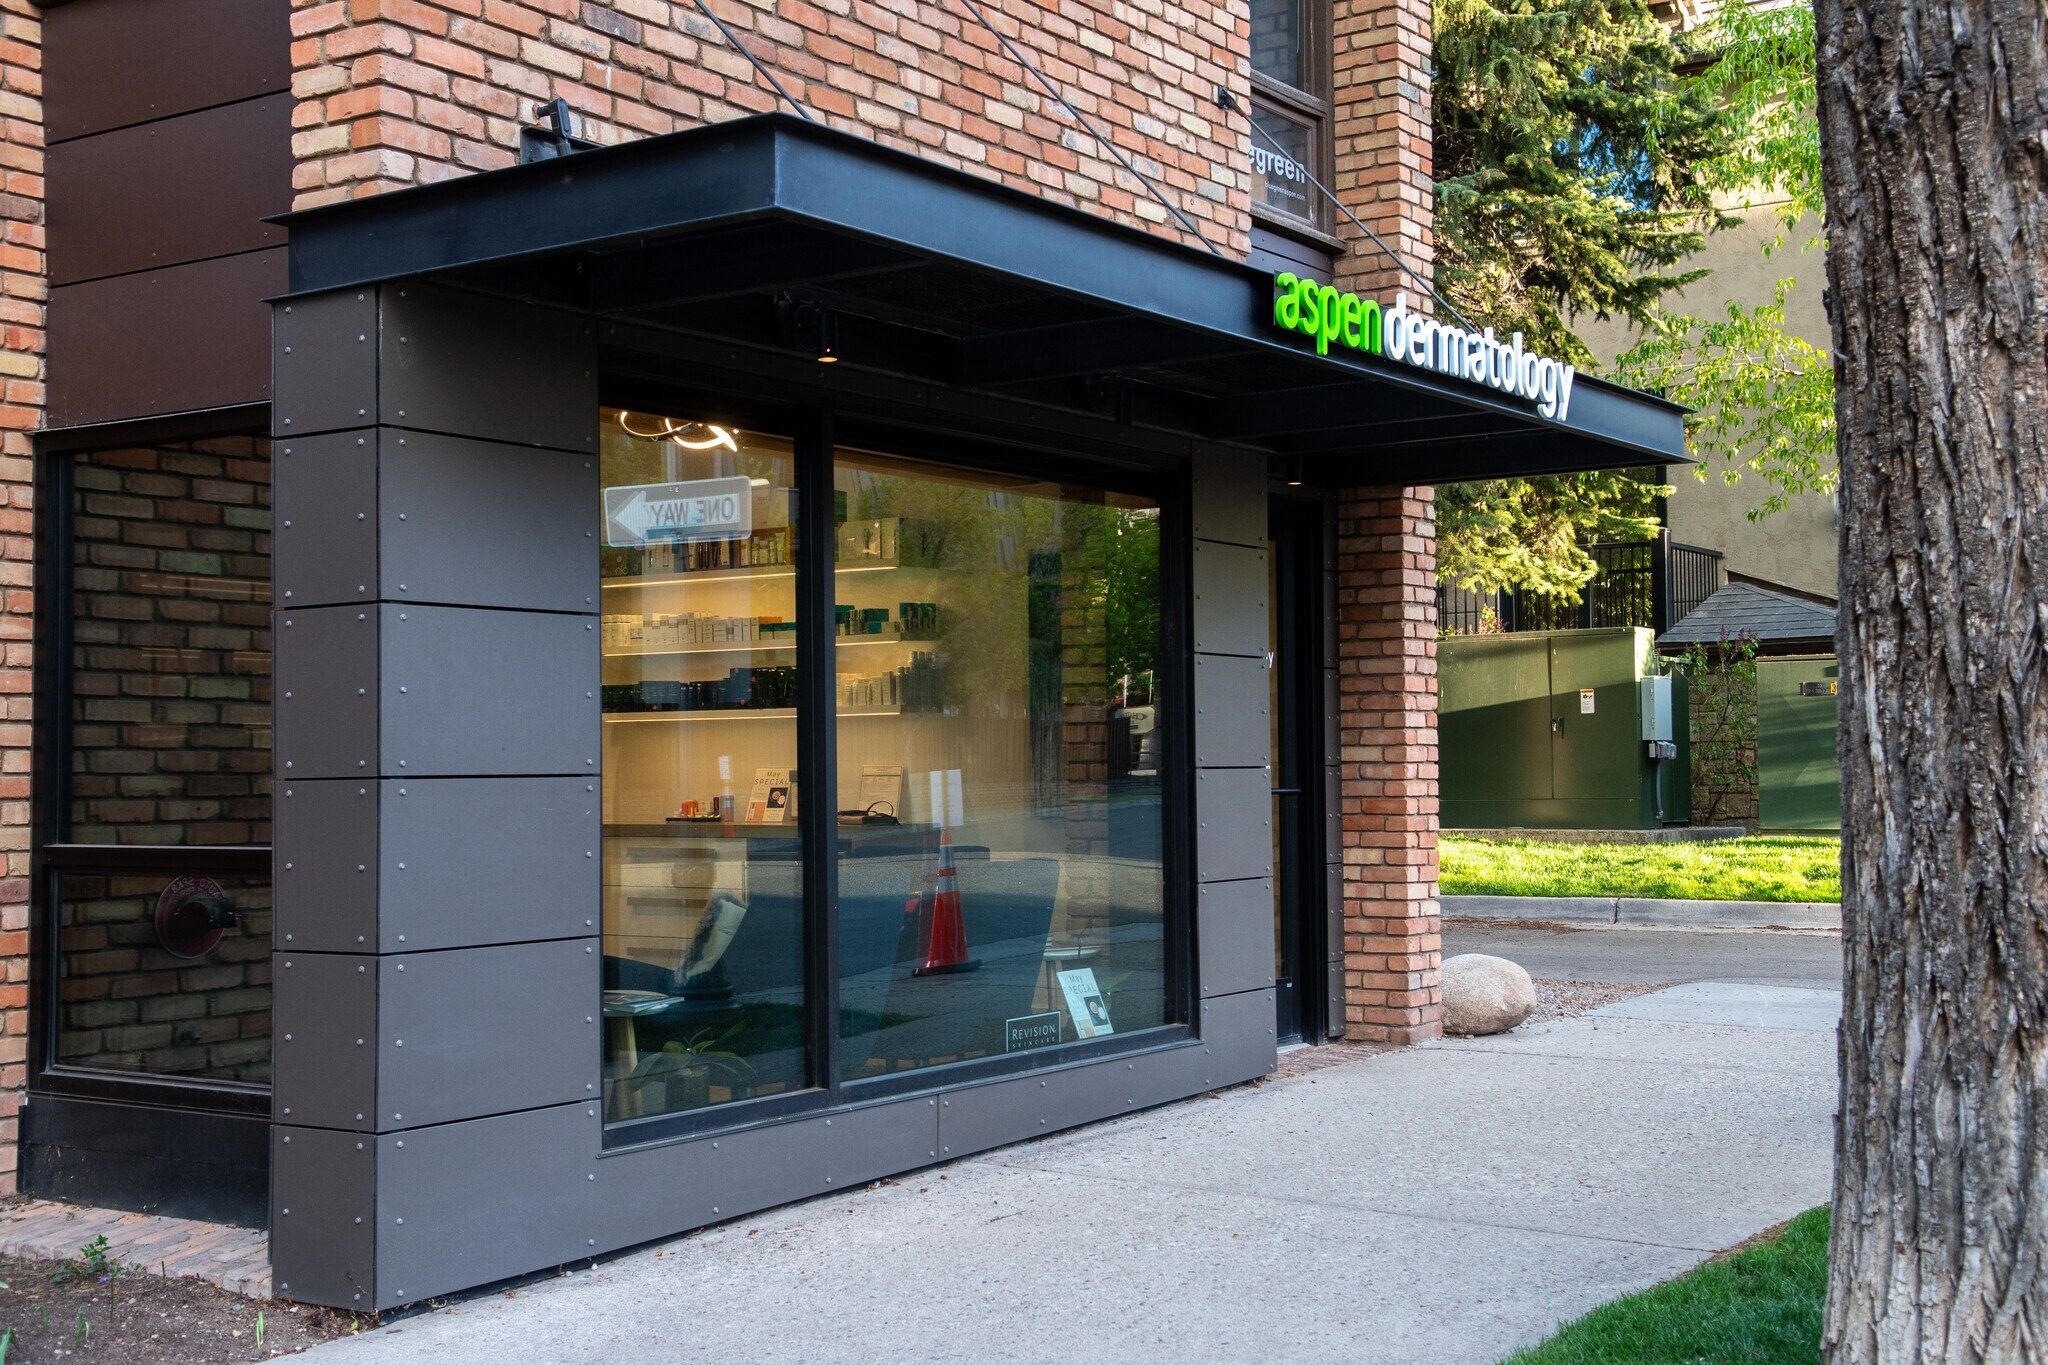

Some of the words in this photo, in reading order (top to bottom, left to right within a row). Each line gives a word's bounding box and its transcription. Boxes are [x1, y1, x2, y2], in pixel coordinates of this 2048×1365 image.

[766, 770, 781, 778] May
[1068, 974, 1083, 983] May
[1012, 1024, 1056, 1041] REVISION
[1012, 1036, 1056, 1049] SKINCARE
